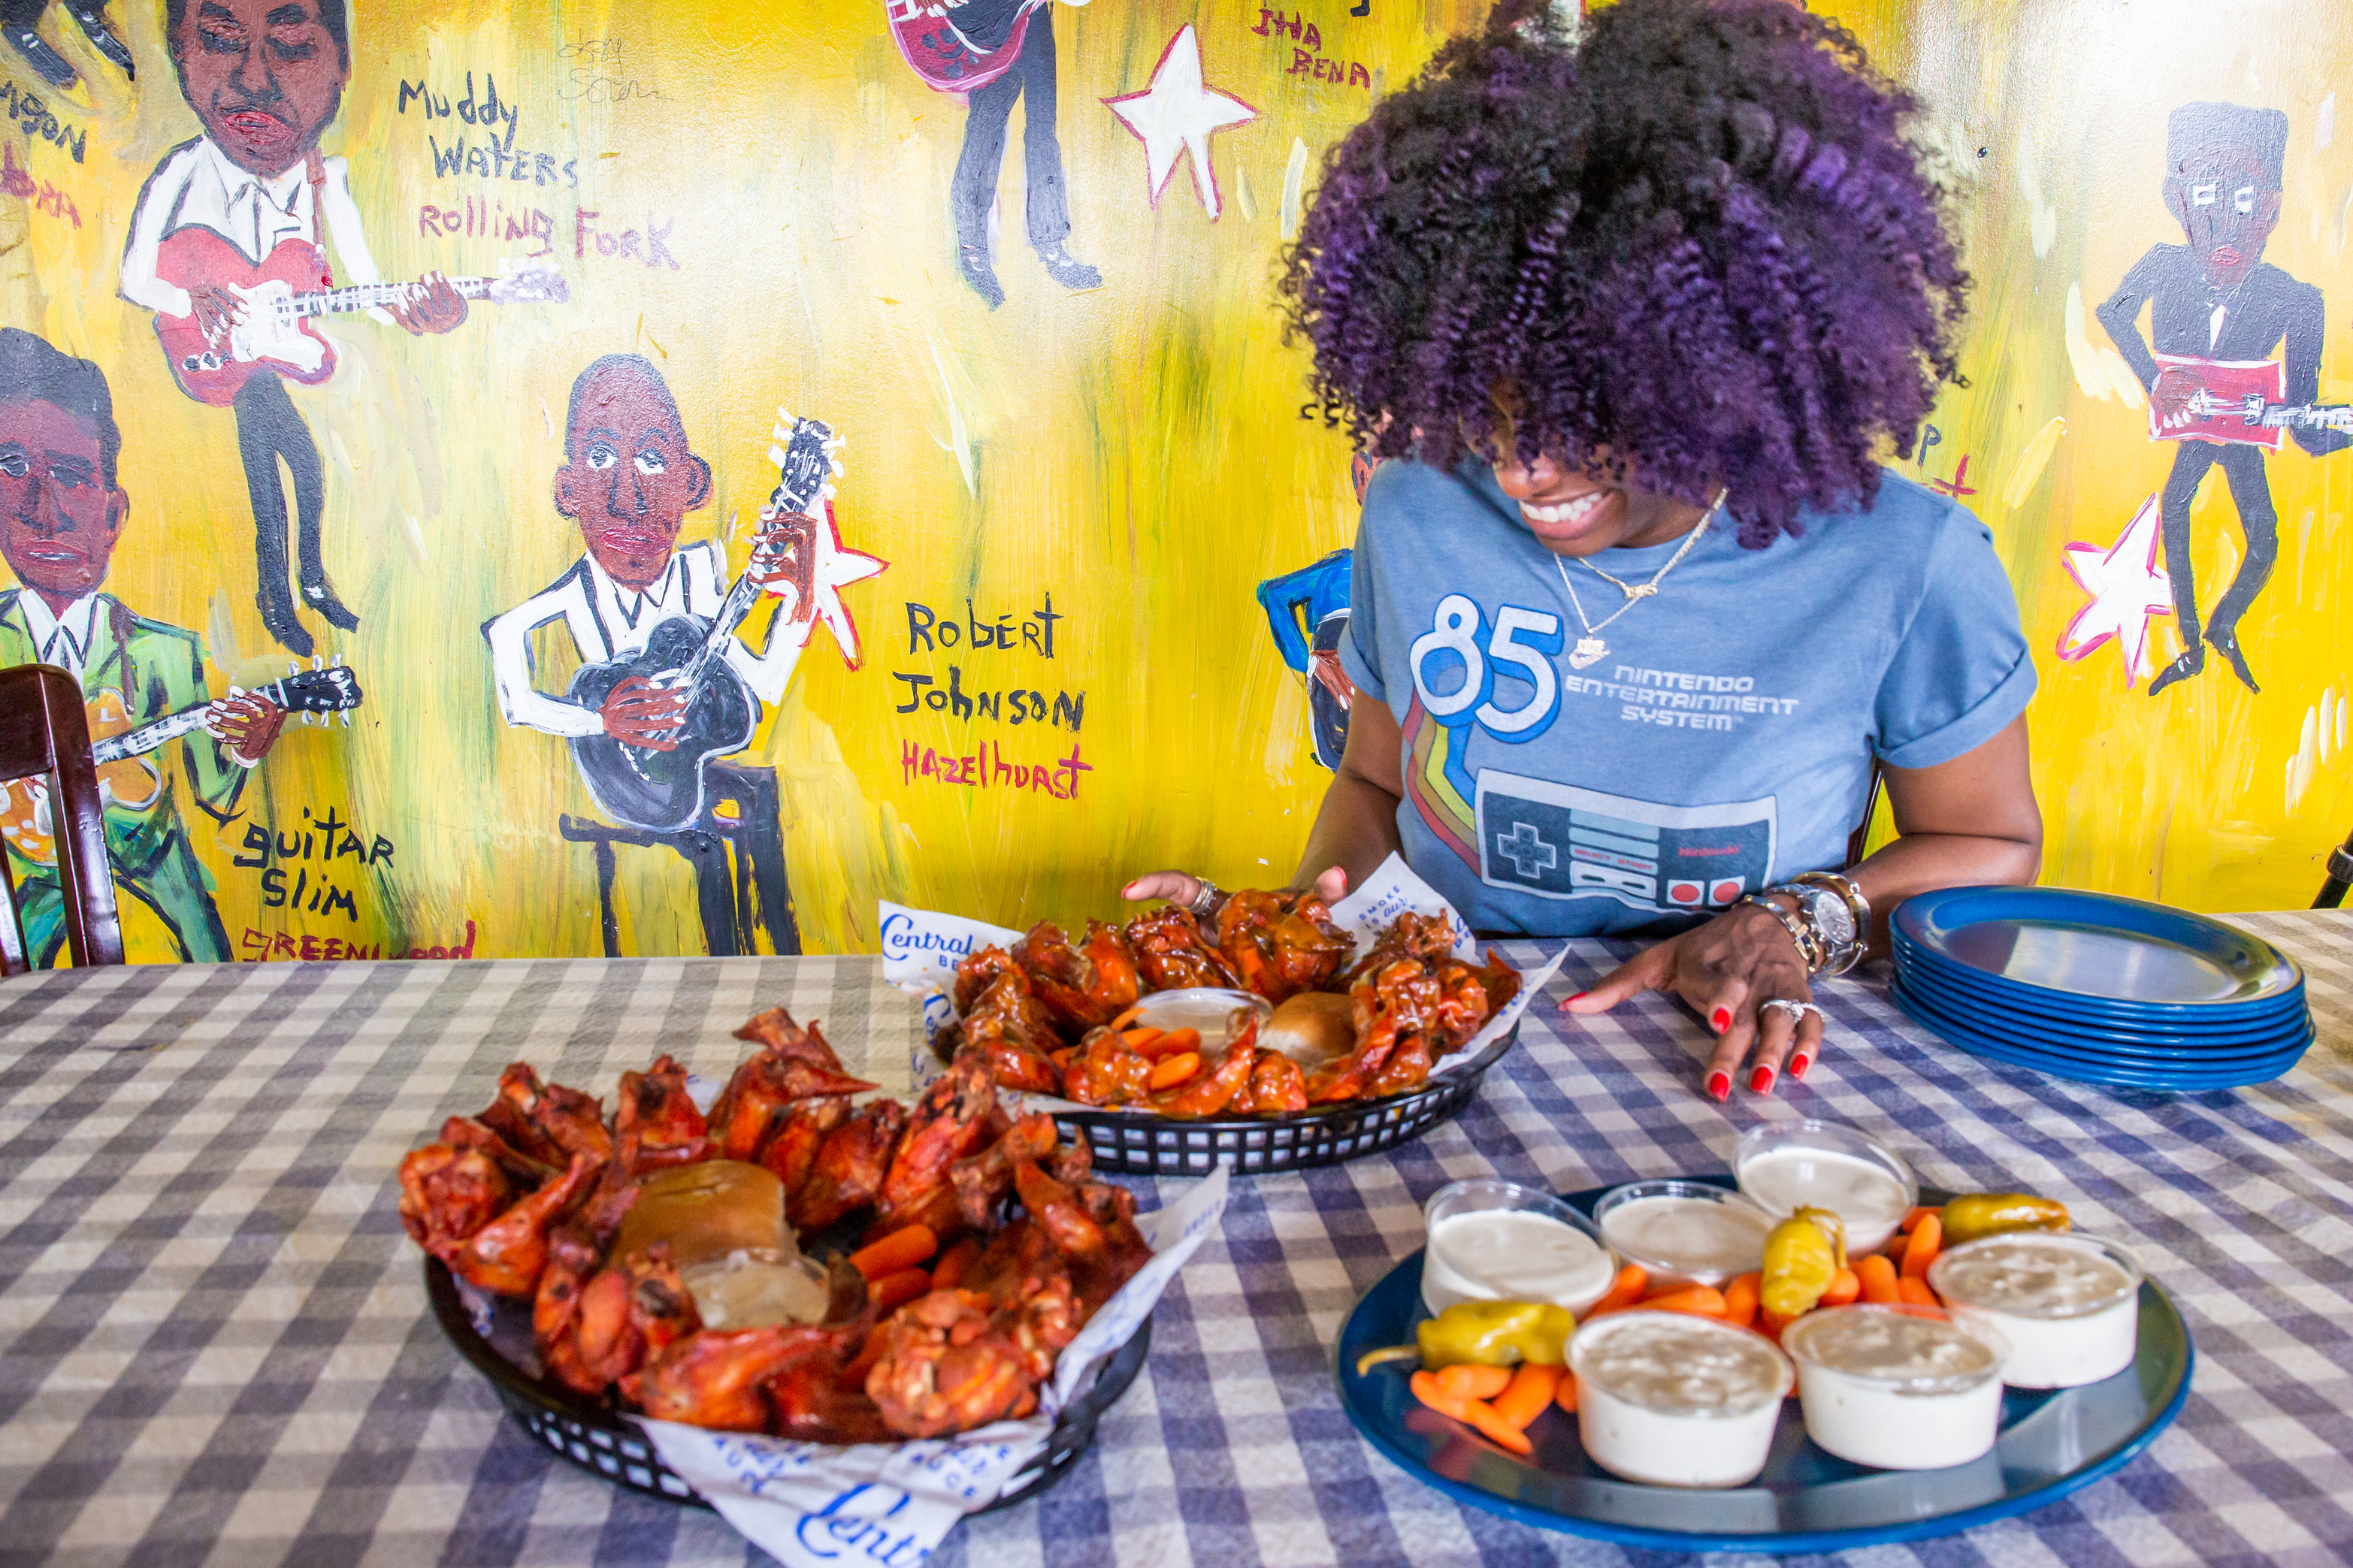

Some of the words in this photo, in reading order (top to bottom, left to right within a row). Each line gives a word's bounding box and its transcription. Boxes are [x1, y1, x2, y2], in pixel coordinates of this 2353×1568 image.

[1286, 47, 1371, 91] BENA
[398, 70, 519, 154] Muddy
[1409, 593, 1564, 742] 85
[881, 913, 975, 962] Central
